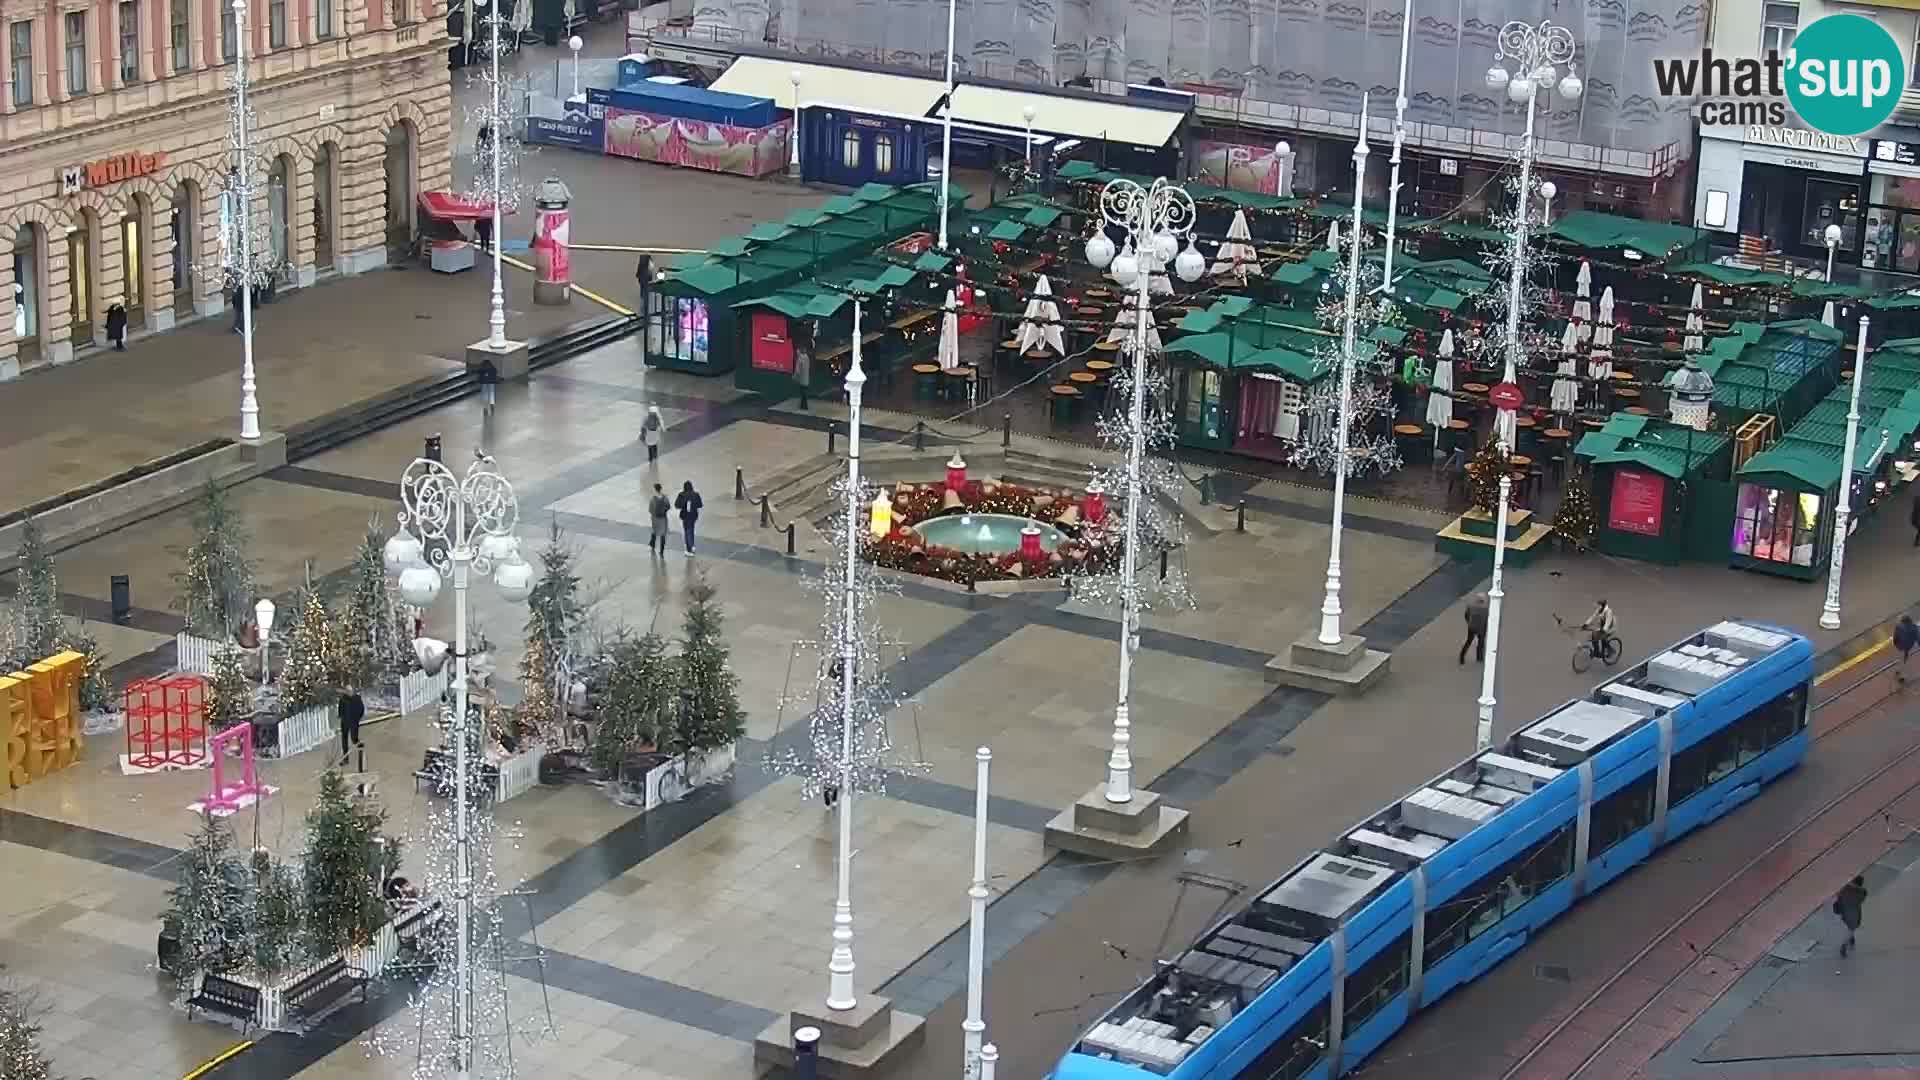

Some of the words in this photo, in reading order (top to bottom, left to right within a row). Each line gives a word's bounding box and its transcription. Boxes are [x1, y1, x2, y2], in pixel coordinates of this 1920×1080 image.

[1750, 125, 1860, 152] MARTIMEX
[65, 173, 77, 188] M
[87, 151, 166, 184] Müller
[1784, 158, 1820, 168] CHANEL
